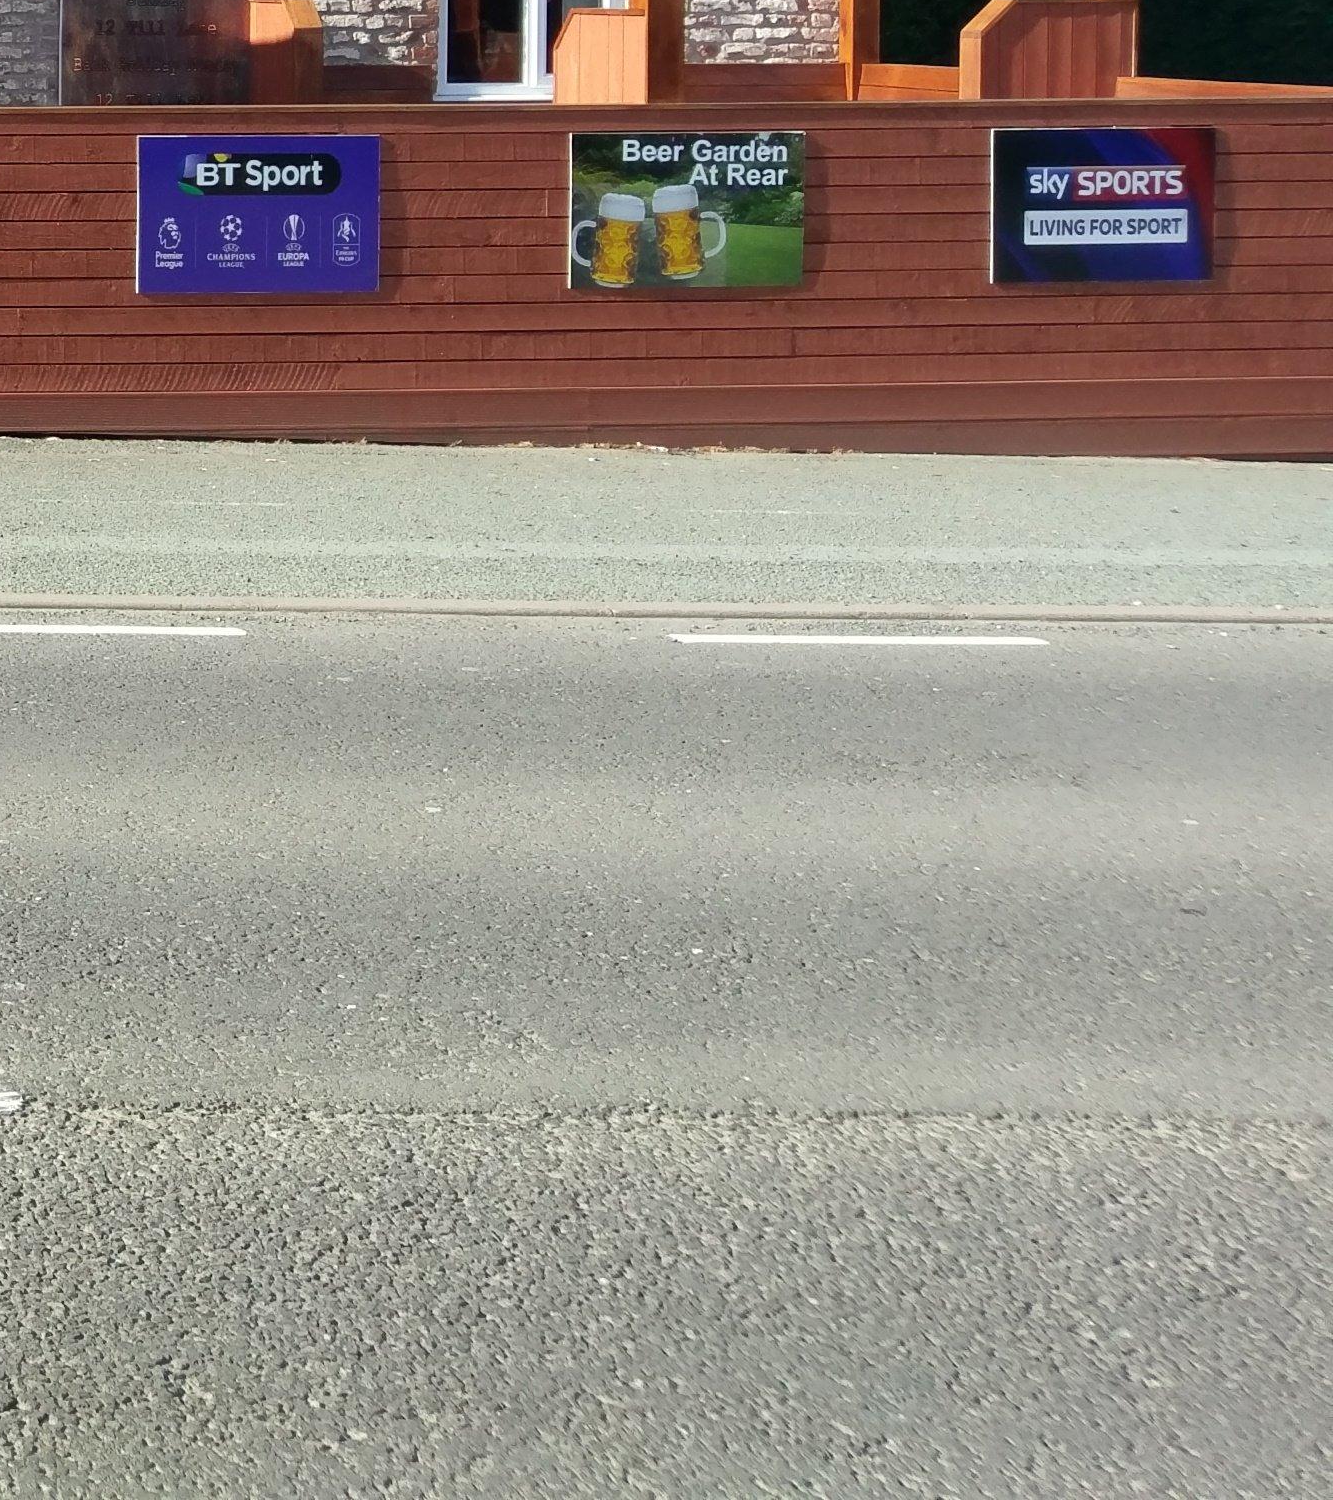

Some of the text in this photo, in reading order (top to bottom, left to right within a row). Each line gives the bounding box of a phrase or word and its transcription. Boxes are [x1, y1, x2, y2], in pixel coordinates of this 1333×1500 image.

[622, 139, 787, 162] Beer Garden
[196, 159, 323, 191] BT Sport
[688, 163, 788, 185] At Rear
[1029, 168, 1183, 200] sky SPORTS
[1029, 218, 1182, 236] LIVING FOR SPORT
[206, 253, 256, 261] CHAMPIONS
[277, 252, 310, 261] EUROPA
